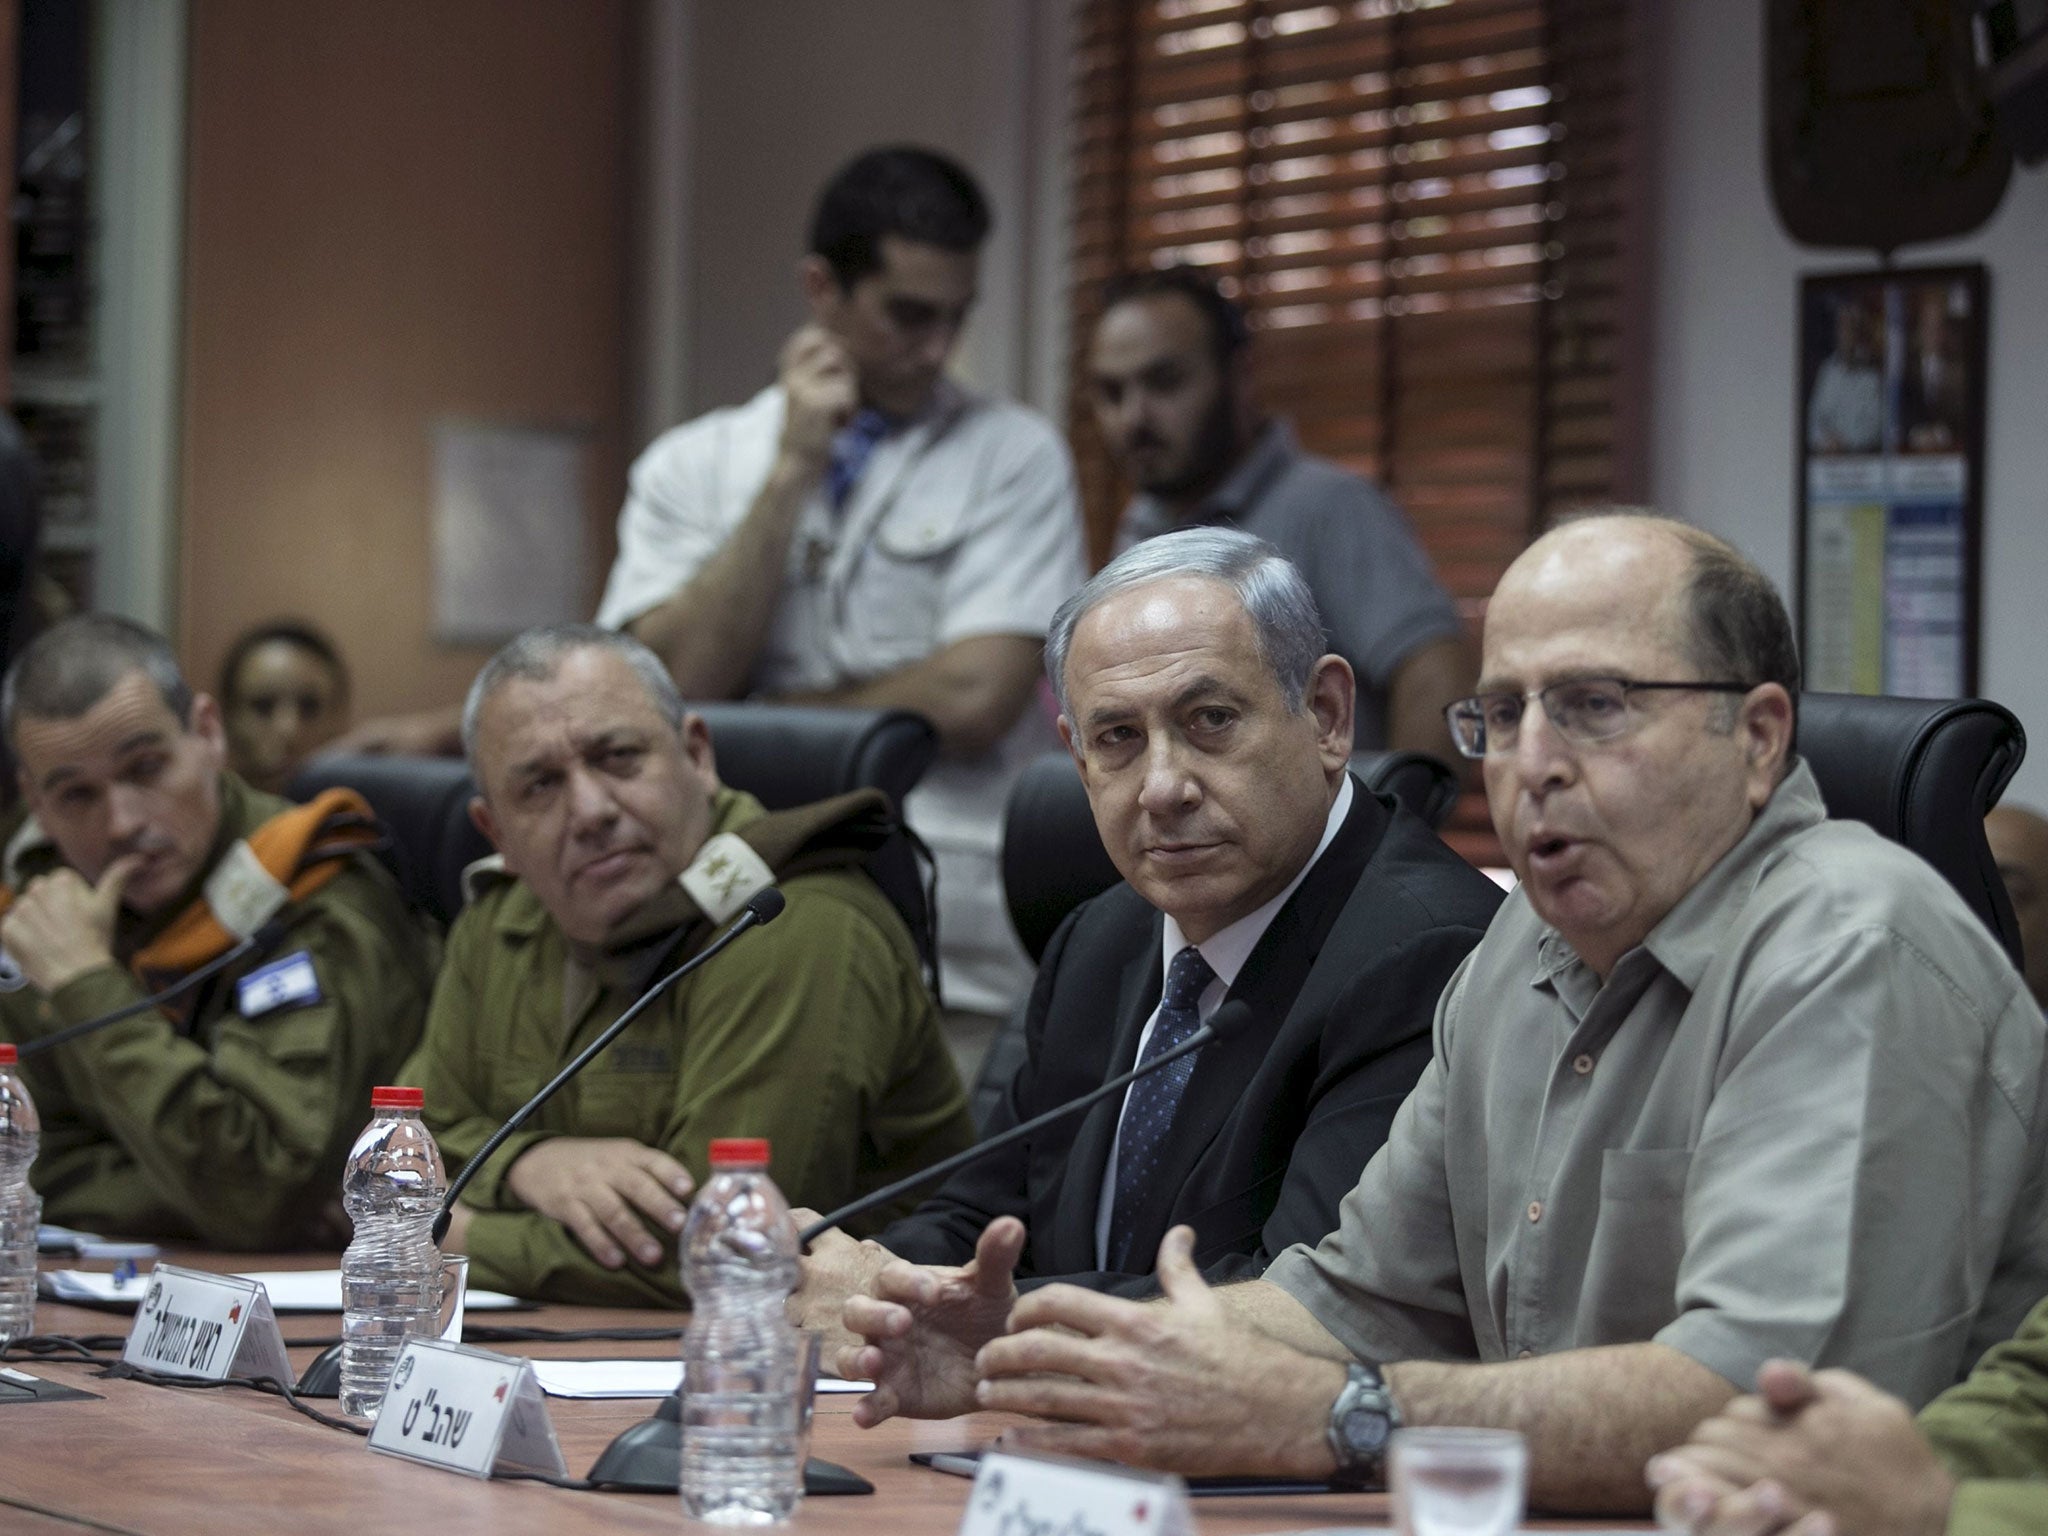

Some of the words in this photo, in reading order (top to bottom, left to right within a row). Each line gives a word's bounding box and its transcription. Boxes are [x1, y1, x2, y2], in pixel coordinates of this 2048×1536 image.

[142, 1294, 197, 1366] הממשלה
[190, 1319, 223, 1371] ראש
[402, 1388, 473, 1449] שהב"ט
